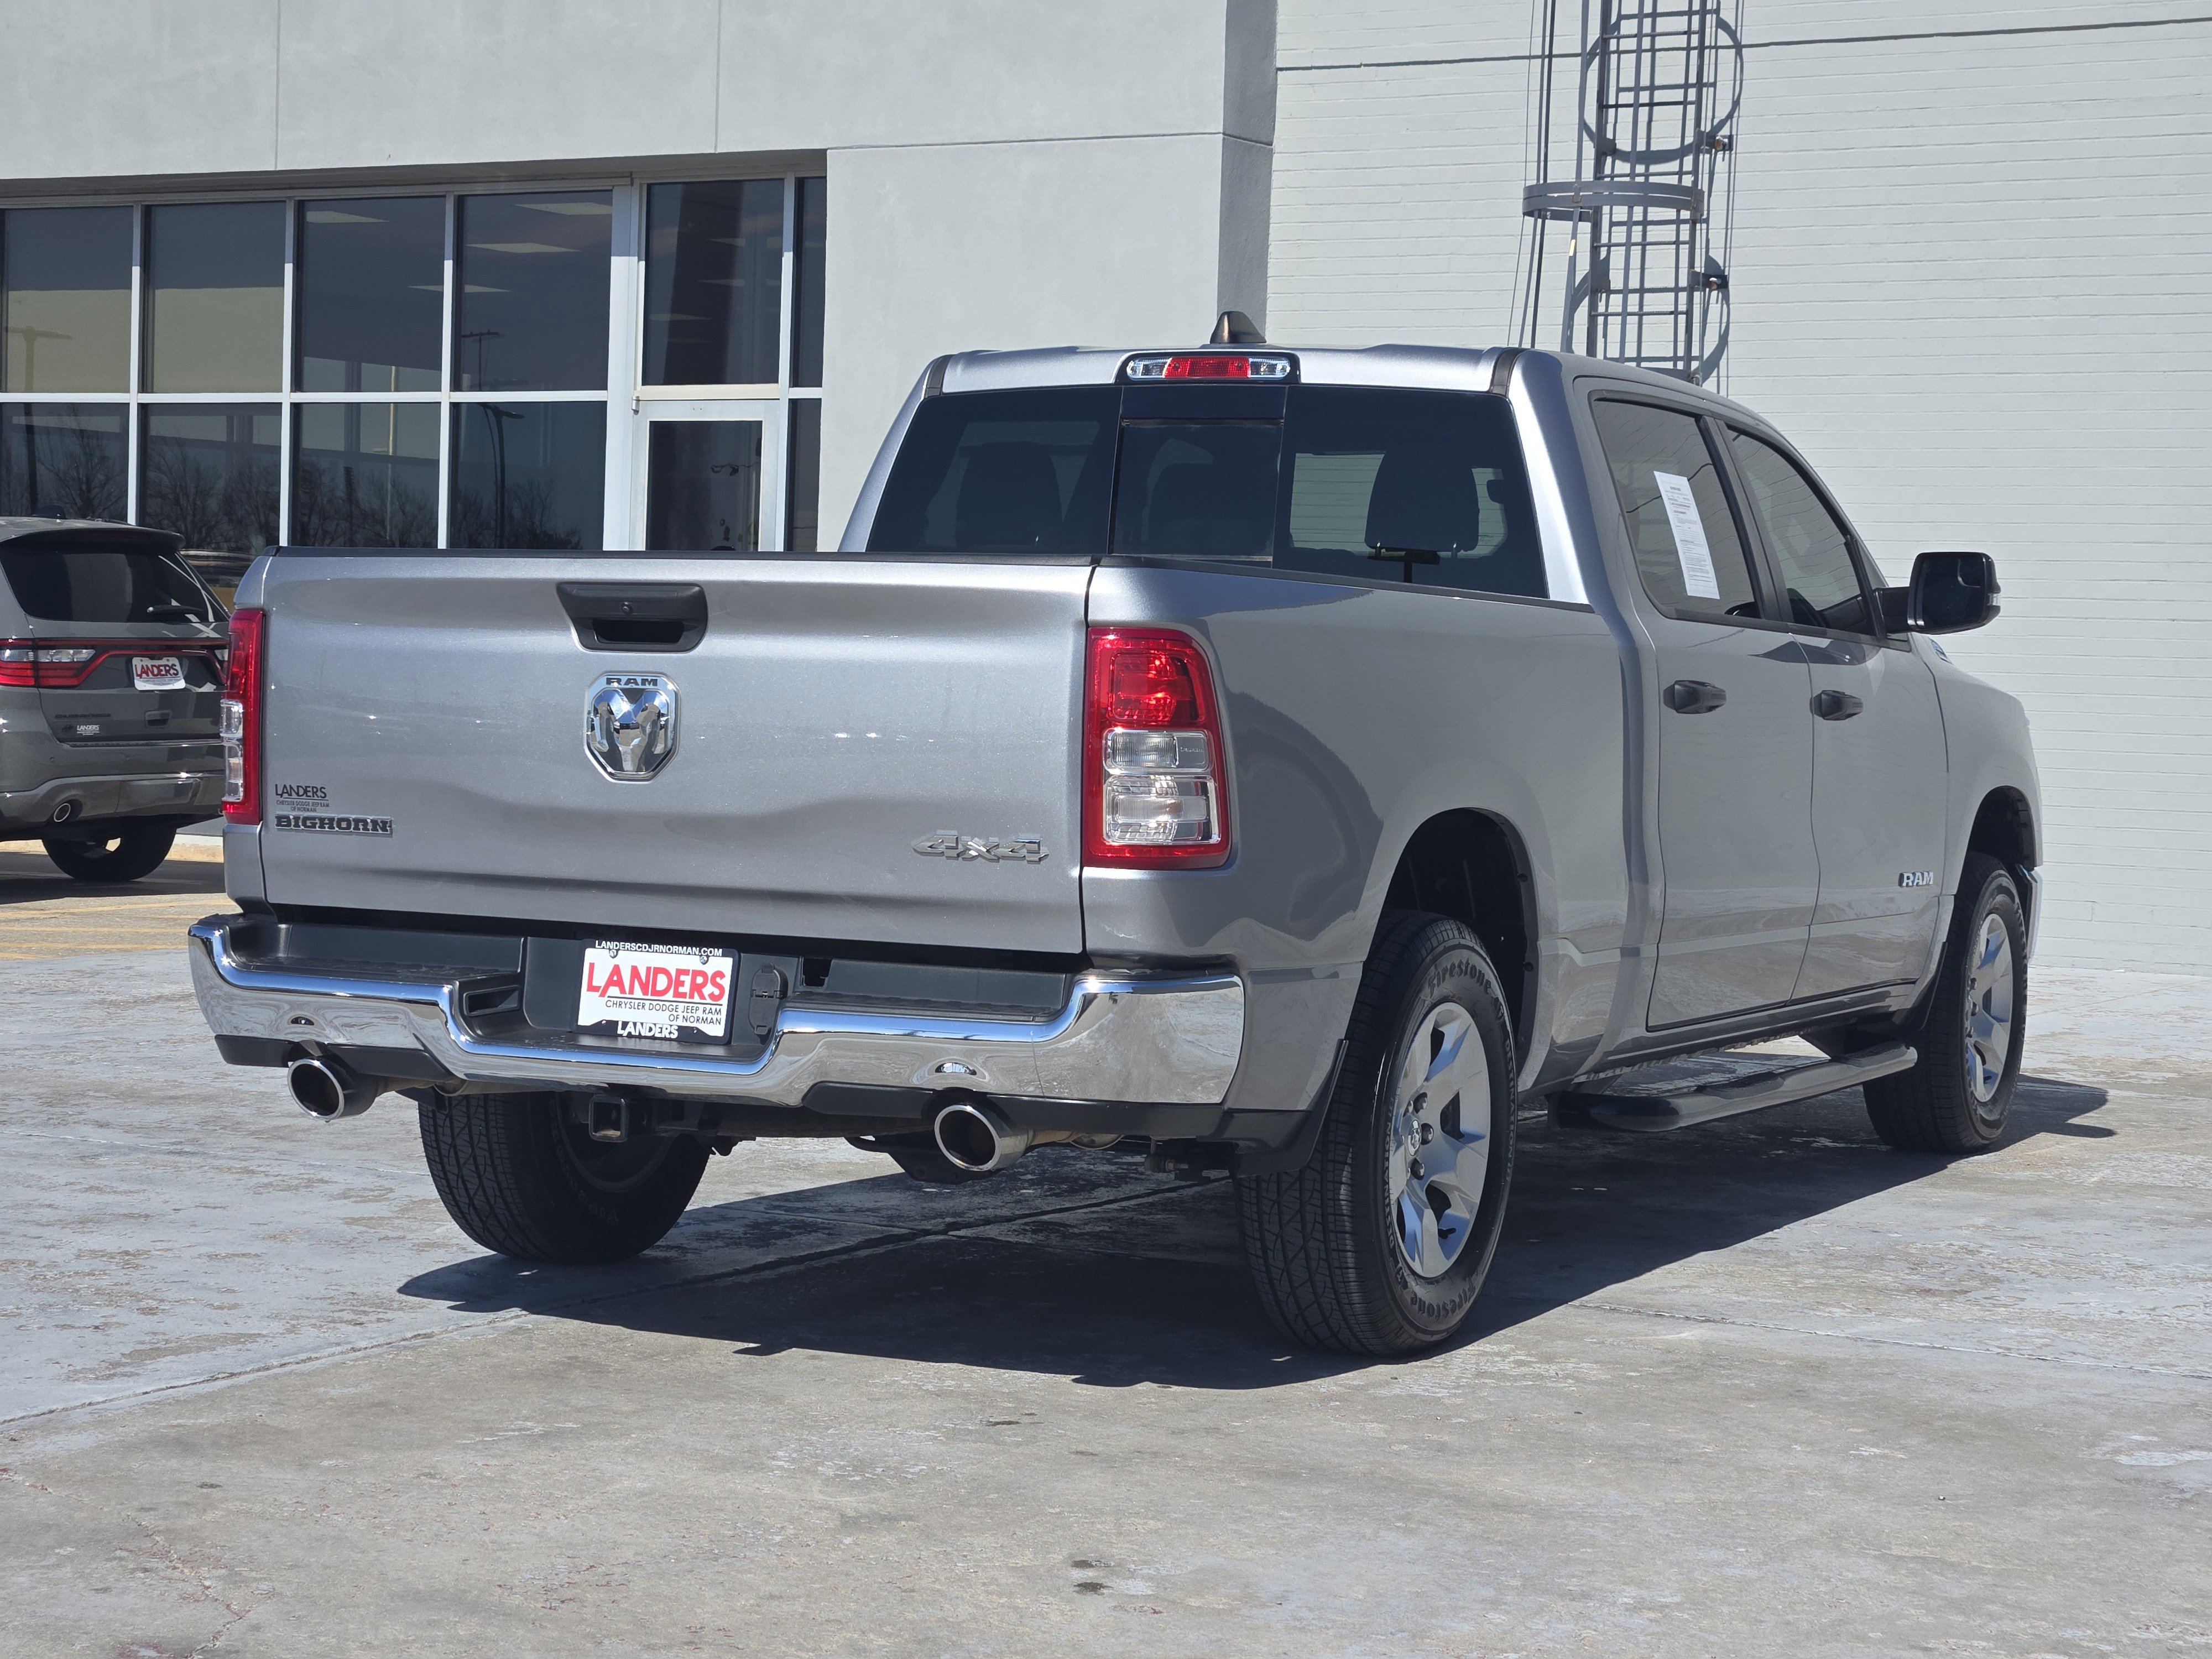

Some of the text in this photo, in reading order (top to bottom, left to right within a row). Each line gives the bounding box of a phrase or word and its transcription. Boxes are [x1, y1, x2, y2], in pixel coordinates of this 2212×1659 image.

[134, 664, 179, 679] LANDERS
[606, 677, 658, 687] RAM
[275, 784, 327, 799] LANDERS
[1899, 870, 1934, 886] RAM
[596, 940, 722, 957] LANDERSCDJRNORMAN.COM
[586, 962, 726, 1002] LANDERS
[1428, 957, 1491, 999] Firestone
[606, 1000, 722, 1016] CHRYSLER DODGE JEEP RAM
[669, 1014, 722, 1025] OF NORMAN
[617, 1020, 679, 1039] LANDERS
[1505, 1038, 1515, 1157] DESTINATION
[1384, 1122, 1395, 1249] DESTINATION
[1410, 1275, 1476, 1321] Firestone
